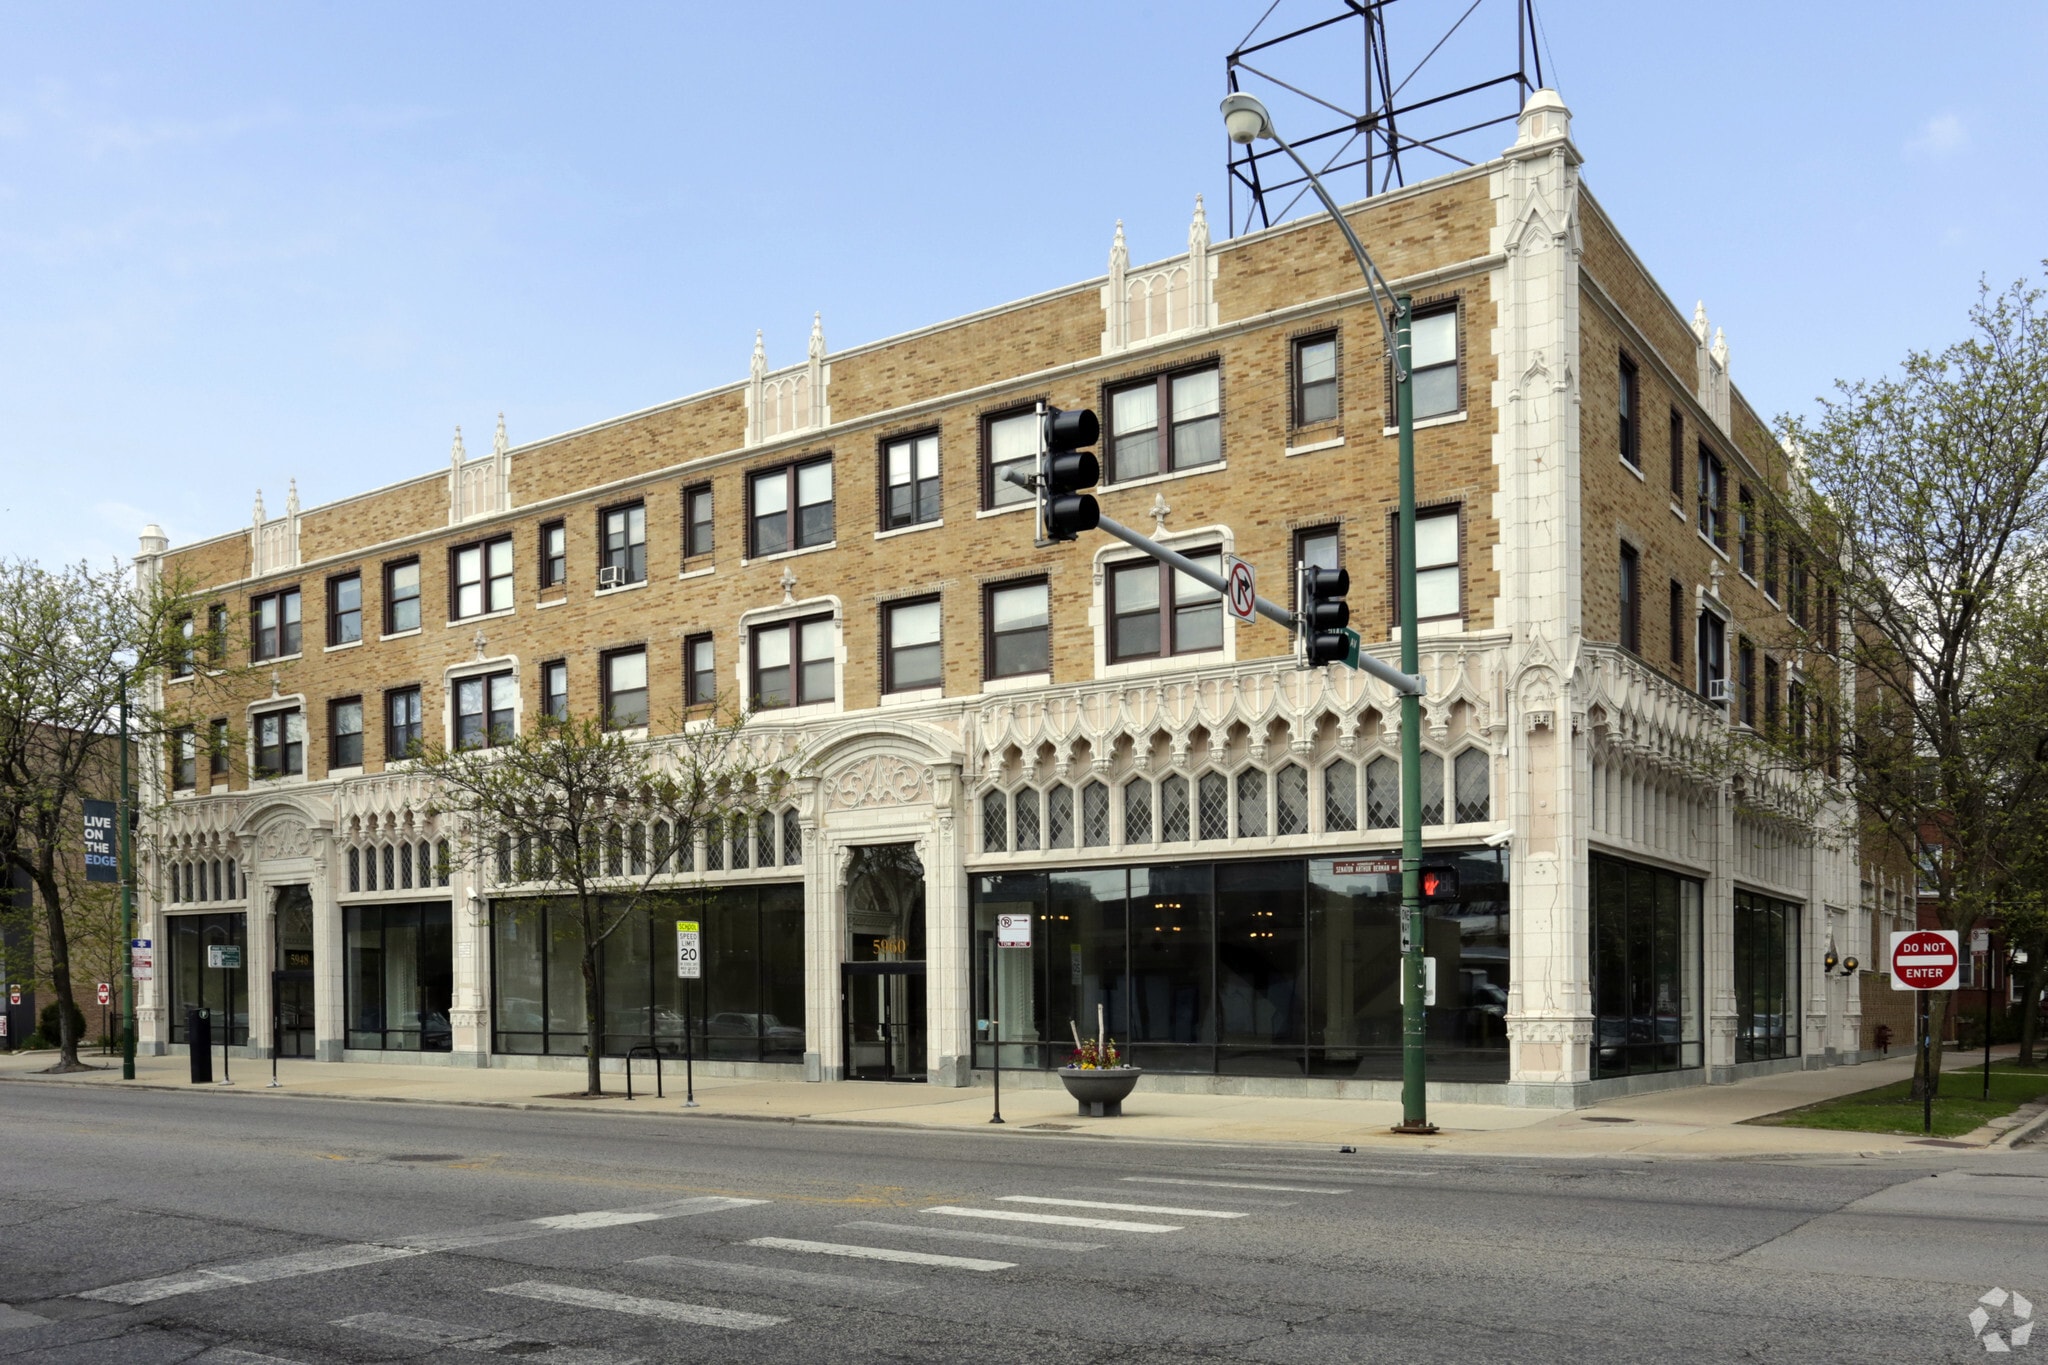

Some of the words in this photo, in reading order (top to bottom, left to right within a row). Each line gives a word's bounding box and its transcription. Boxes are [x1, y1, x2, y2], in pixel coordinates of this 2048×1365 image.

[84, 815, 111, 829] LIVE
[84, 828, 103, 840] ON
[84, 841, 109, 853] THE
[85, 854, 117, 867] EDGE
[680, 932, 698, 940] SPEED
[1903, 943, 1919, 952] DO
[1923, 942, 1946, 952] NOT
[681, 948, 697, 961] 20
[1906, 968, 1943, 978] ENTER
